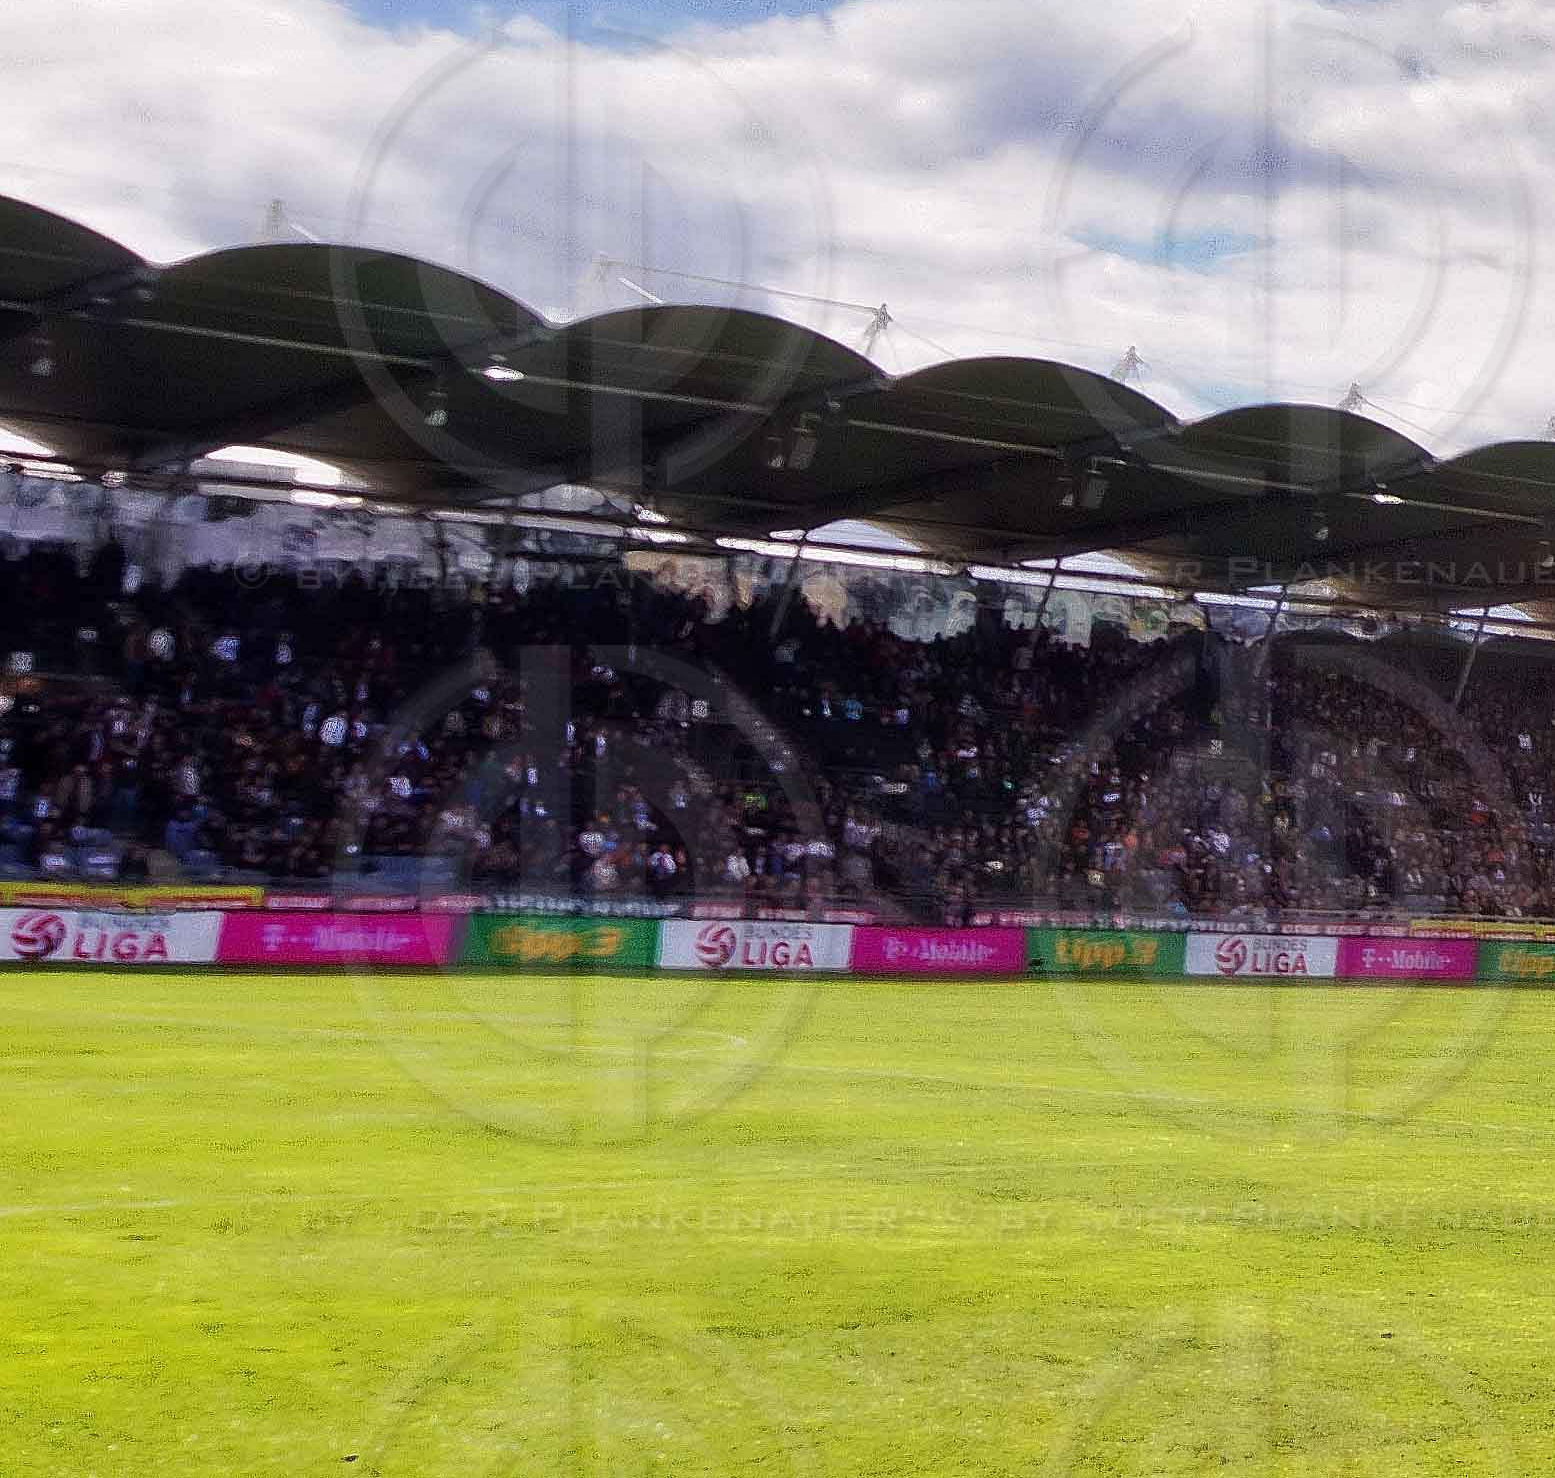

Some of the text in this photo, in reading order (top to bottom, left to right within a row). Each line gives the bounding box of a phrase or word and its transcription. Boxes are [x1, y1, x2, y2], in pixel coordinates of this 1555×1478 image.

[71, 932, 168, 960] LIGA
[740, 940, 814, 968] LIGA
[1252, 952, 1308, 973] LIGA
